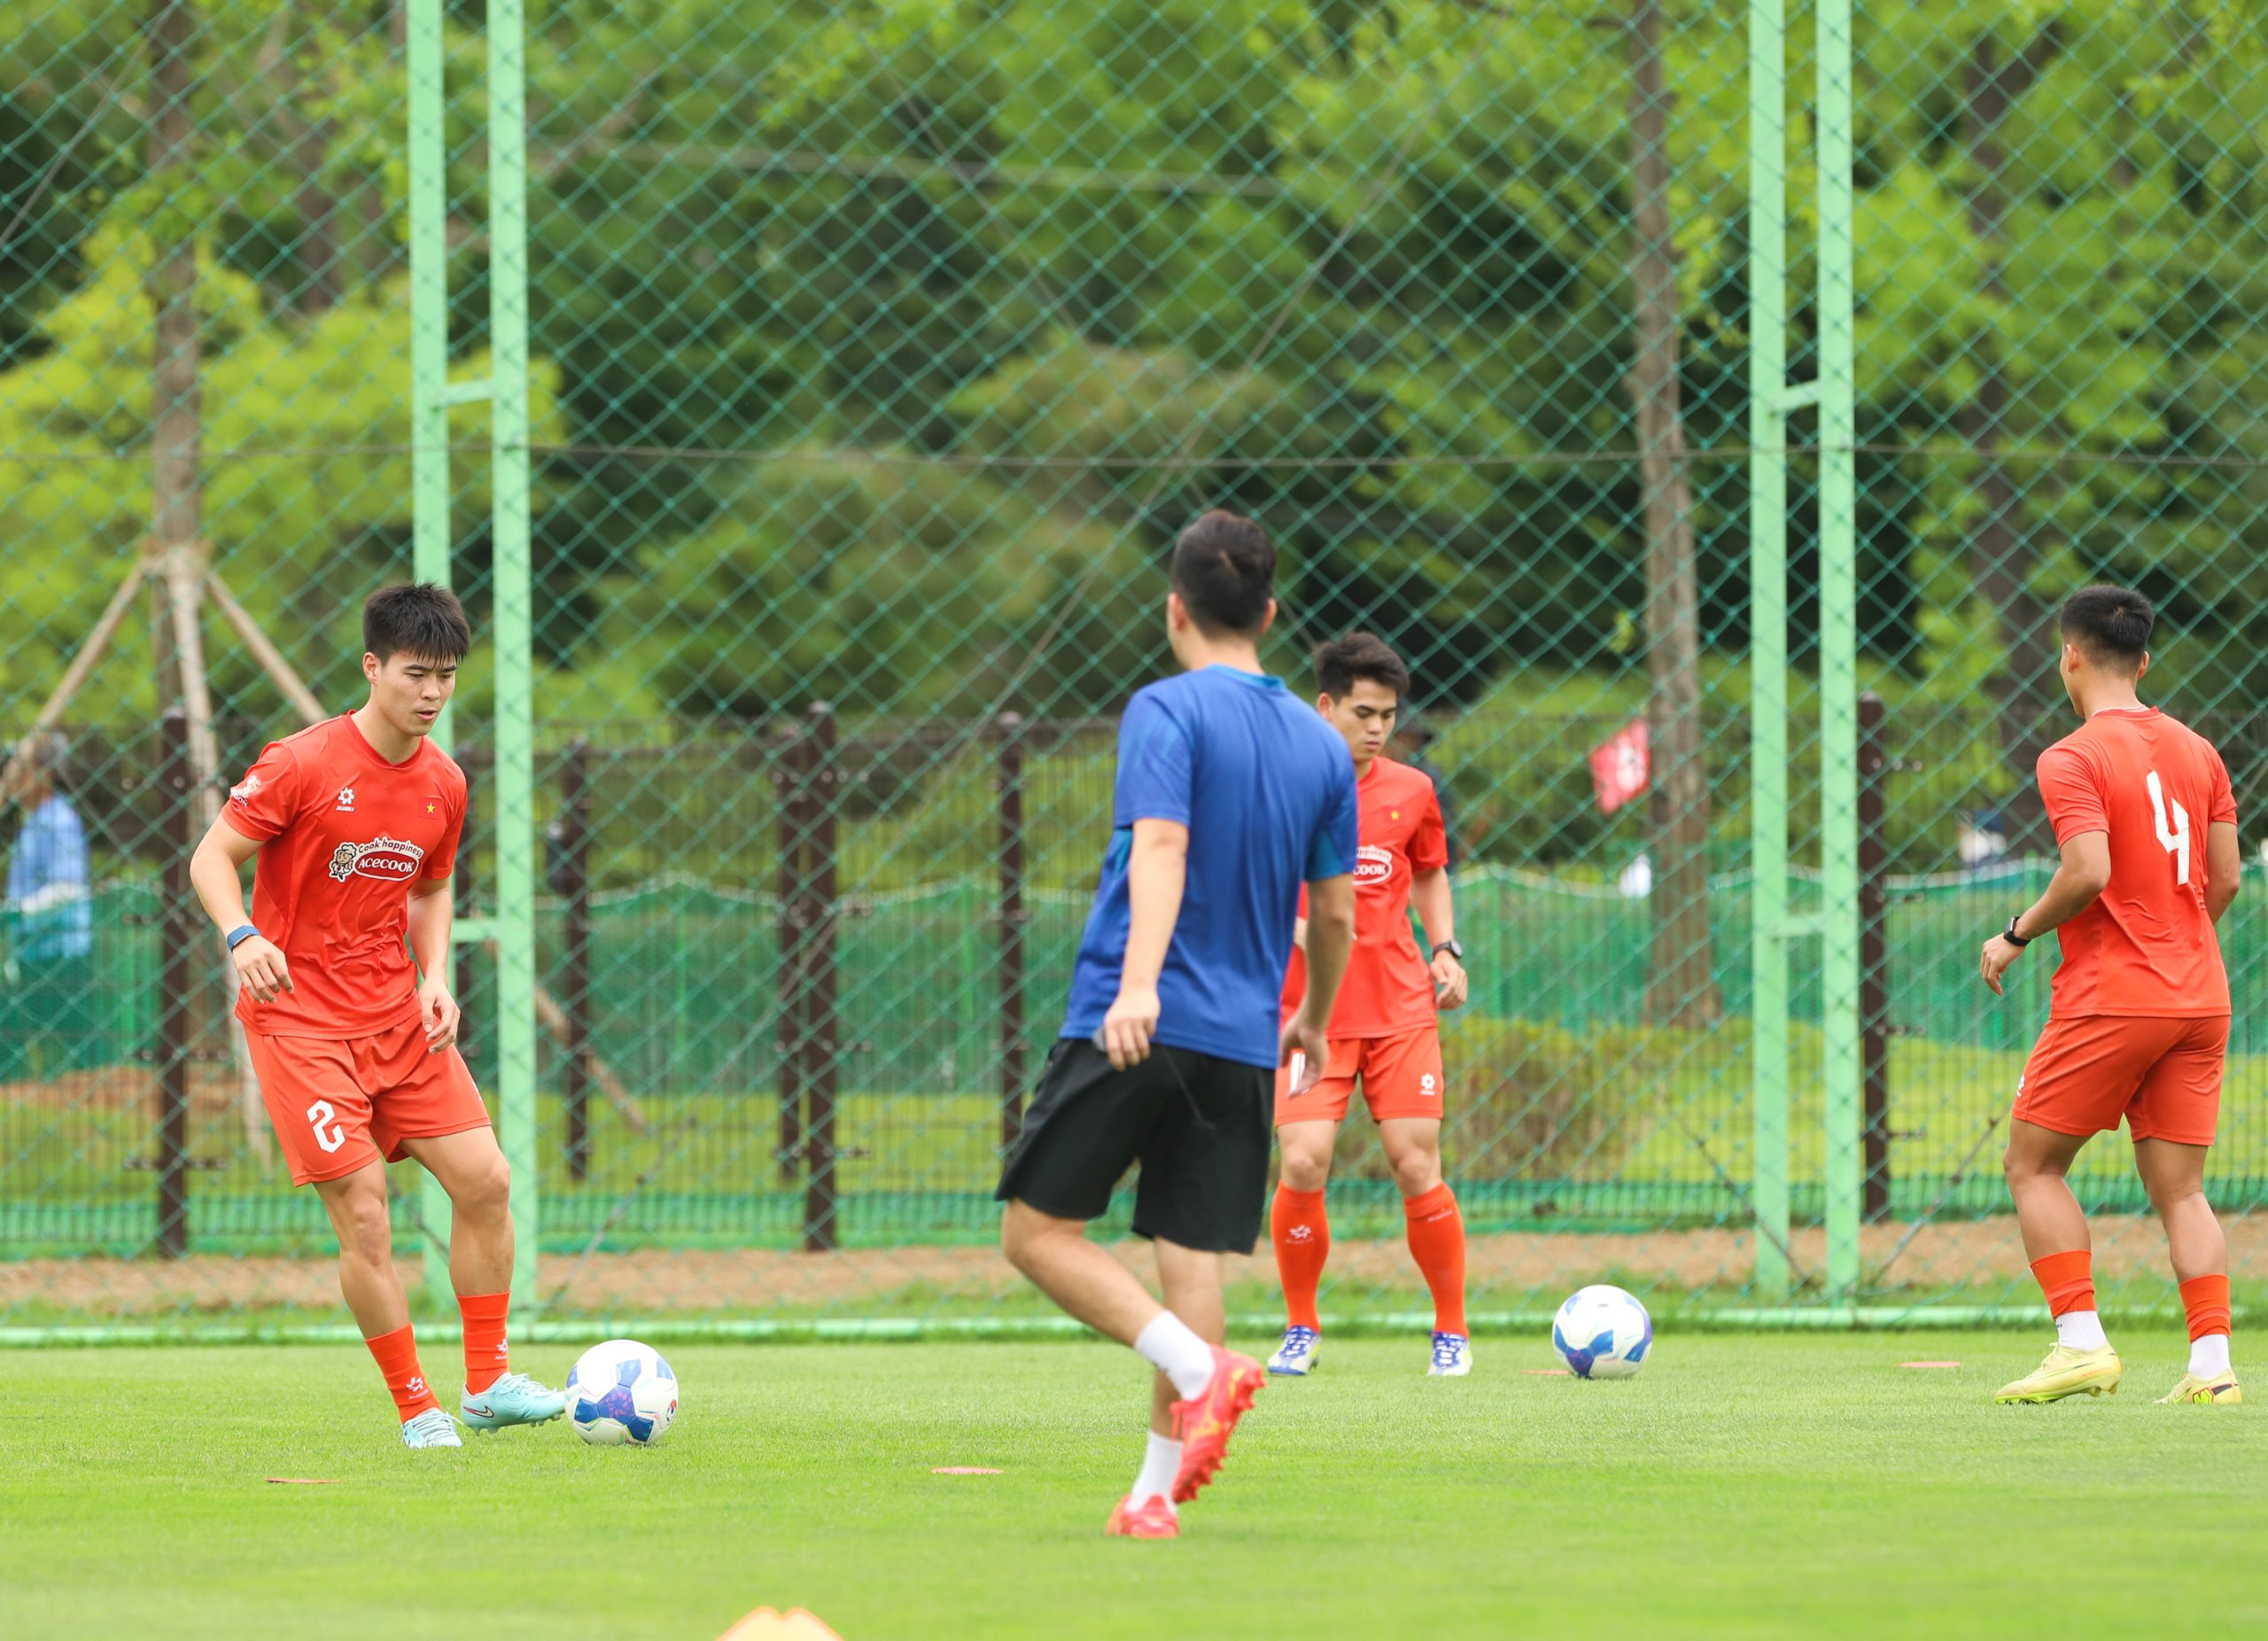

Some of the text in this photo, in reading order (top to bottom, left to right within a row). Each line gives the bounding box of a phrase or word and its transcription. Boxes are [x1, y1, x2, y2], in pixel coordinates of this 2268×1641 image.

[358, 838, 423, 858] Cook happiness
[2146, 769, 2190, 886] 4
[306, 1099, 346, 1153] 2
